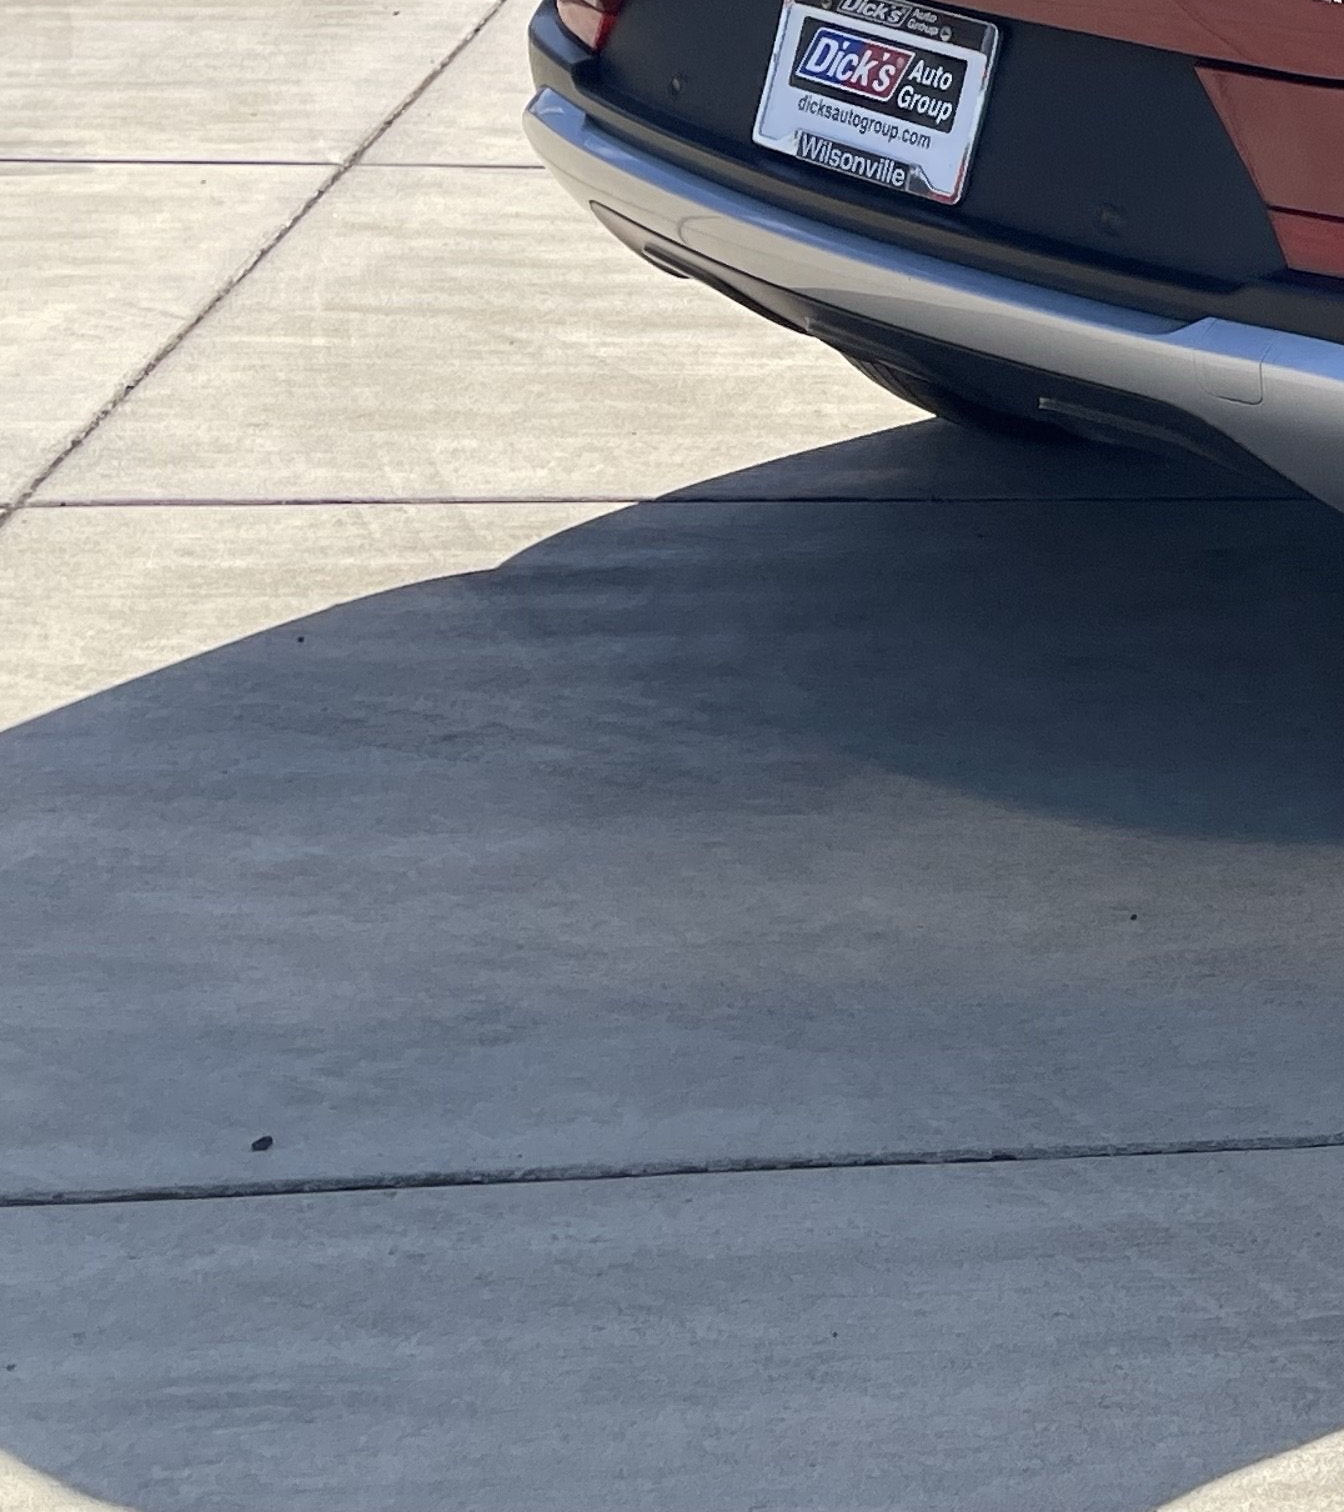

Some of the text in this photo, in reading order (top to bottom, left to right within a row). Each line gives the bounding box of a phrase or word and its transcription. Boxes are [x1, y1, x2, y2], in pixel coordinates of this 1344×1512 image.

[911, 8, 938, 23] Auto
[804, 37, 899, 93] Dick's
[908, 60, 953, 91] Auto
[798, 94, 931, 150] dicksautogroup.com
[897, 86, 952, 124] Group
[801, 134, 906, 187] Wilsonville
